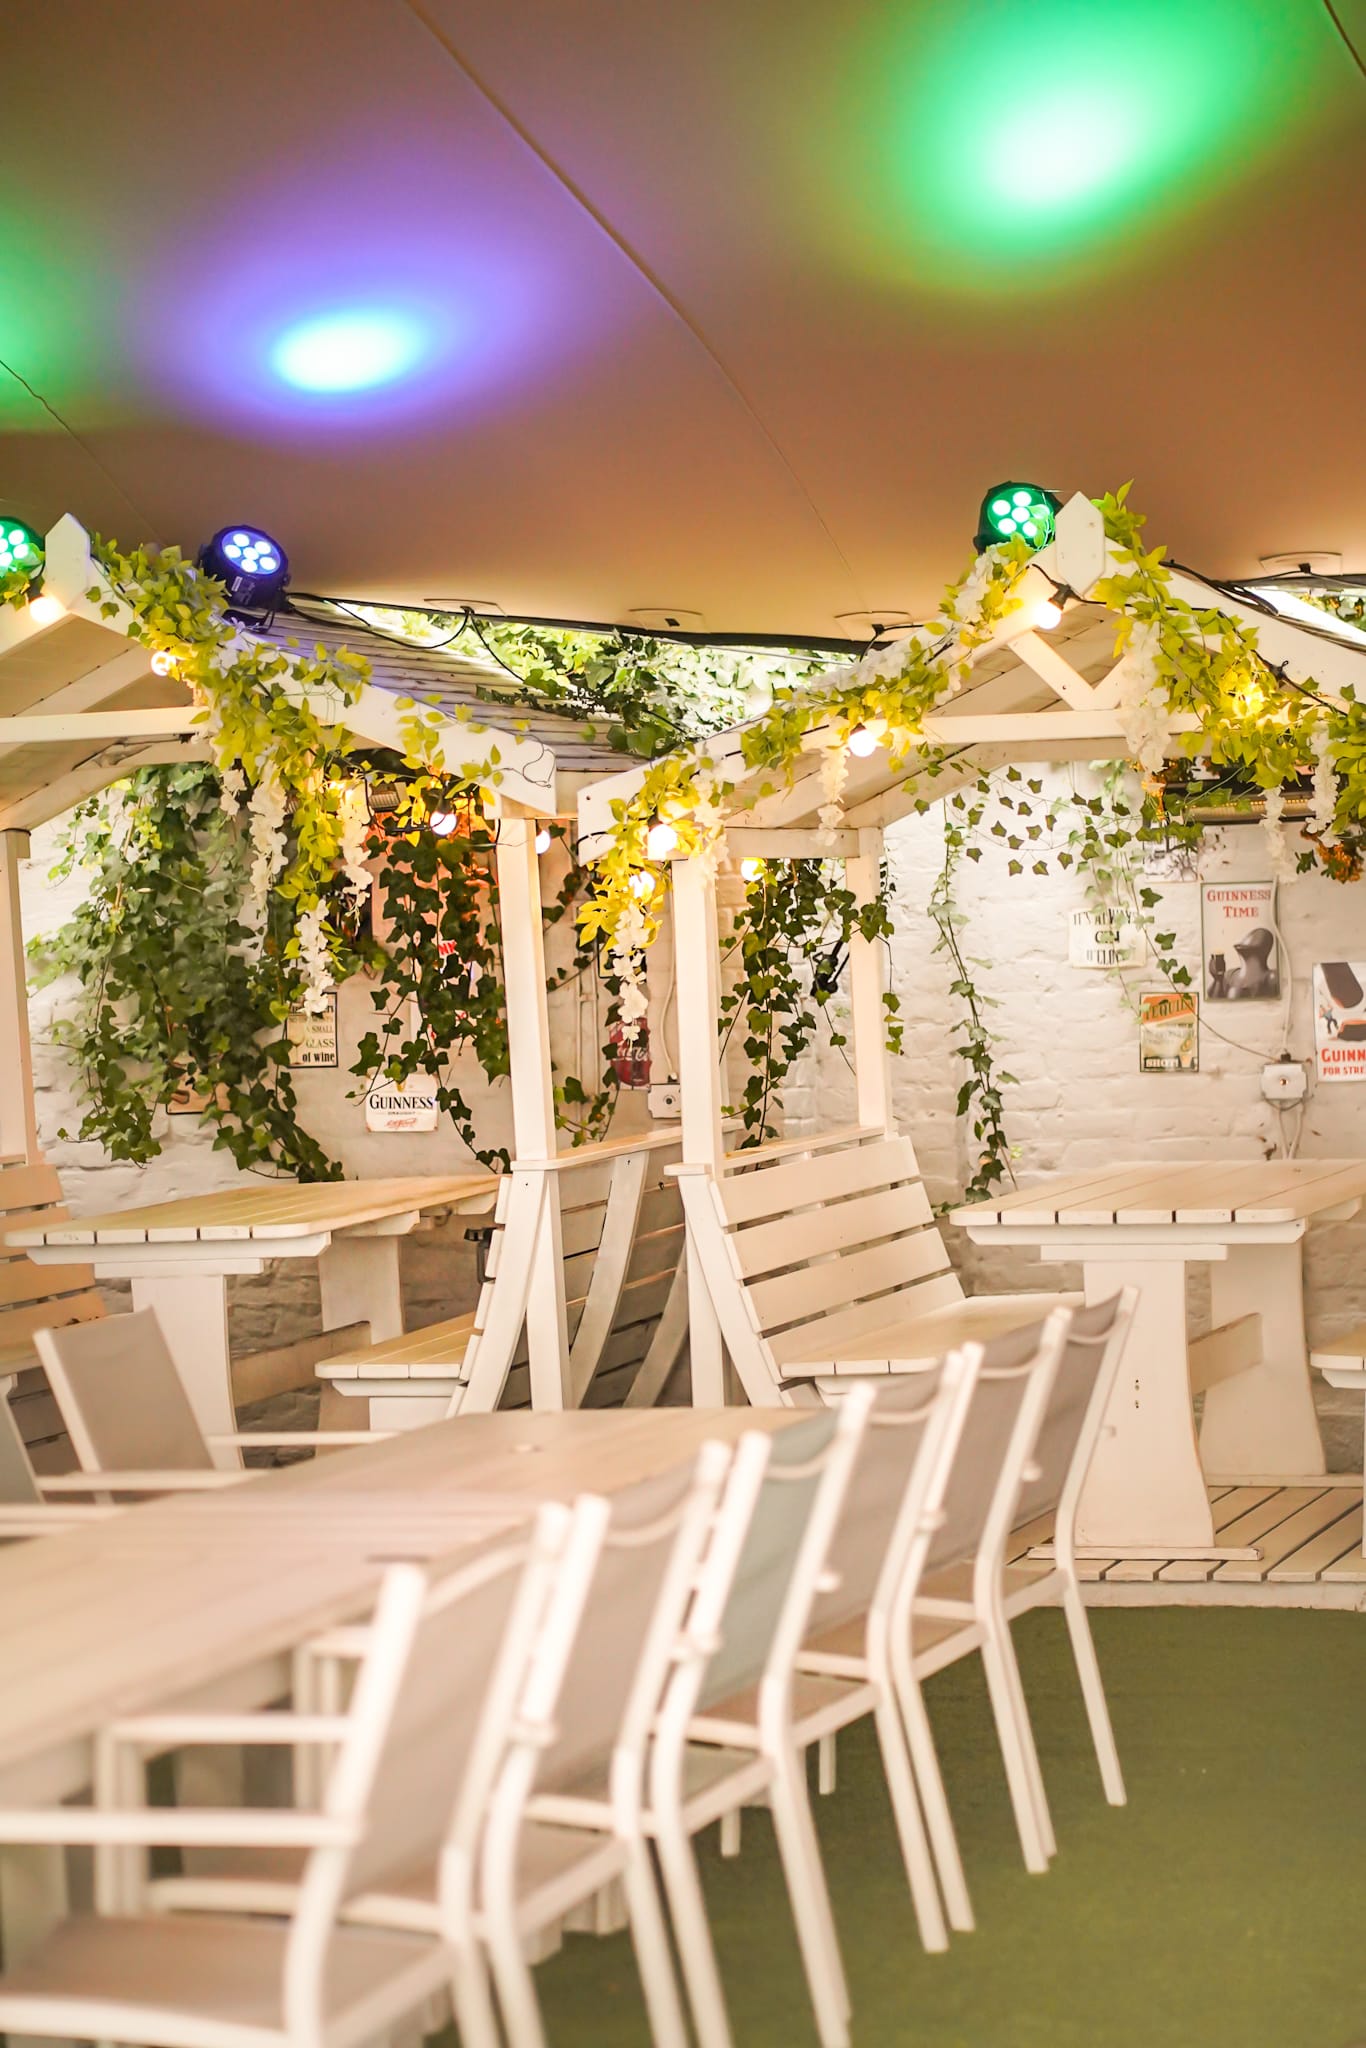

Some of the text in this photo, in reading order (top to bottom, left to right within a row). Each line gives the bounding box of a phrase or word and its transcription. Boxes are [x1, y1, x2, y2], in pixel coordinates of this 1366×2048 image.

[1206, 889, 1272, 902] GUINNESS
[1223, 905, 1259, 918] TIME
[306, 1039, 334, 1048] GLASS
[302, 1051, 335, 1062] of wine
[369, 1094, 434, 1110] GUINNESS
